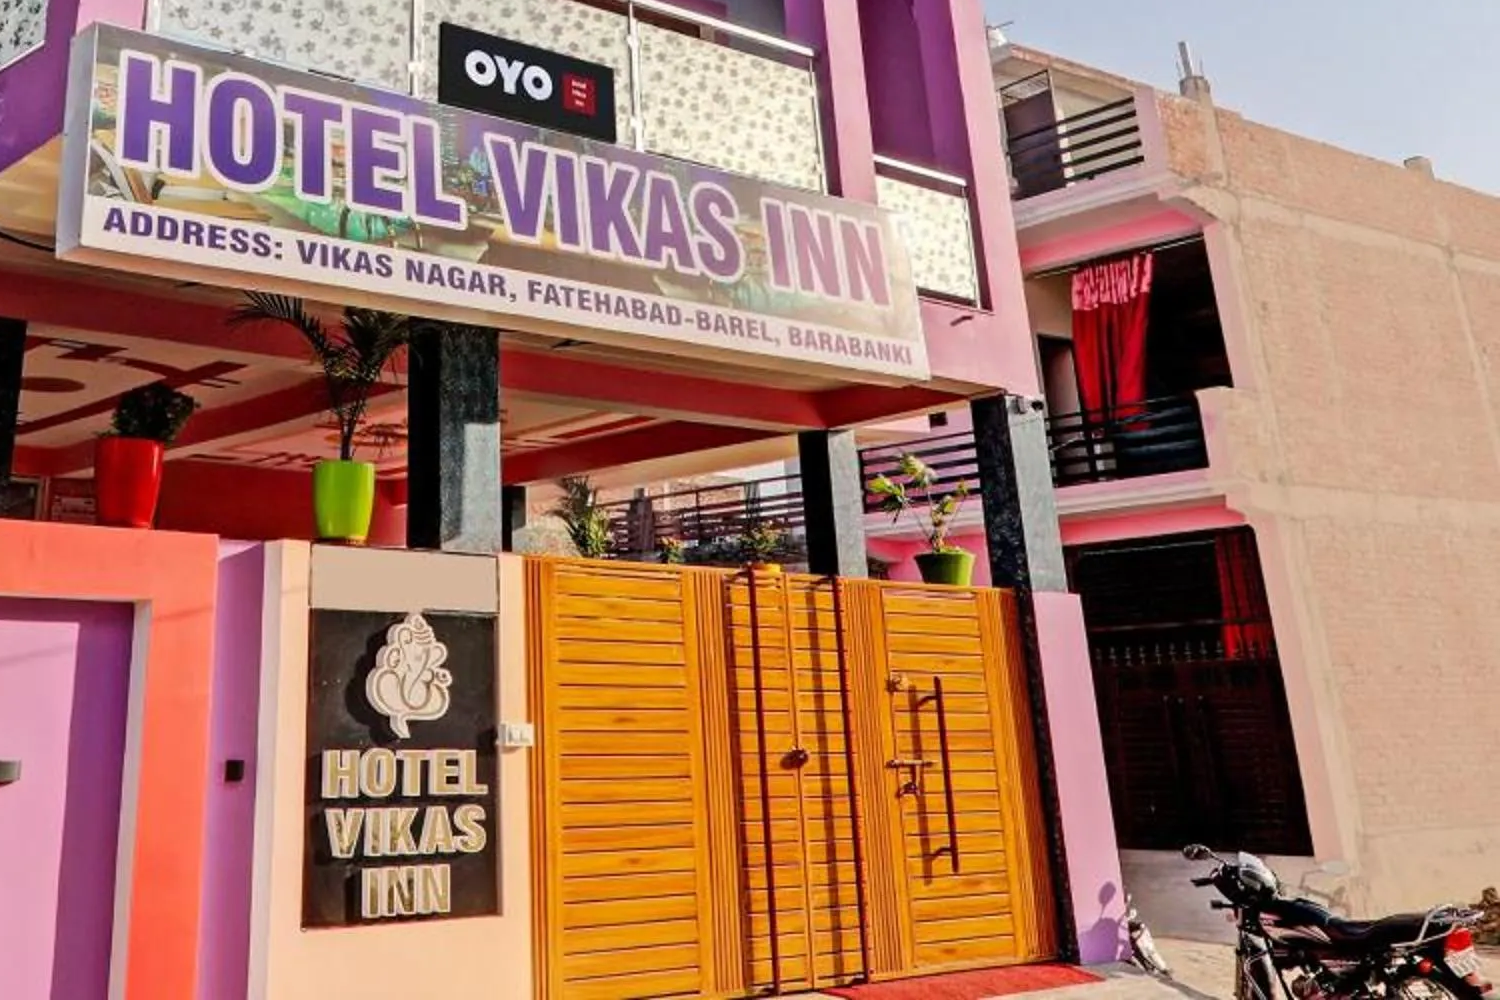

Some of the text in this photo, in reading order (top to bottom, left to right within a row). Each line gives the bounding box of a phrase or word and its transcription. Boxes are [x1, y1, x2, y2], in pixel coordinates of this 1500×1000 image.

[464, 50, 553, 101] OYO
[120, 49, 892, 306] HOTEL VIKAS INN
[103, 206, 283, 260] ADDRESS:
[296, 239, 394, 278] VIKAS
[404, 258, 518, 303] NAGAR,
[788, 326, 913, 366] BARABANKI
[321, 748, 489, 798] HOTEL
[324, 804, 487, 858] VIKAS
[362, 863, 451, 918] INN
